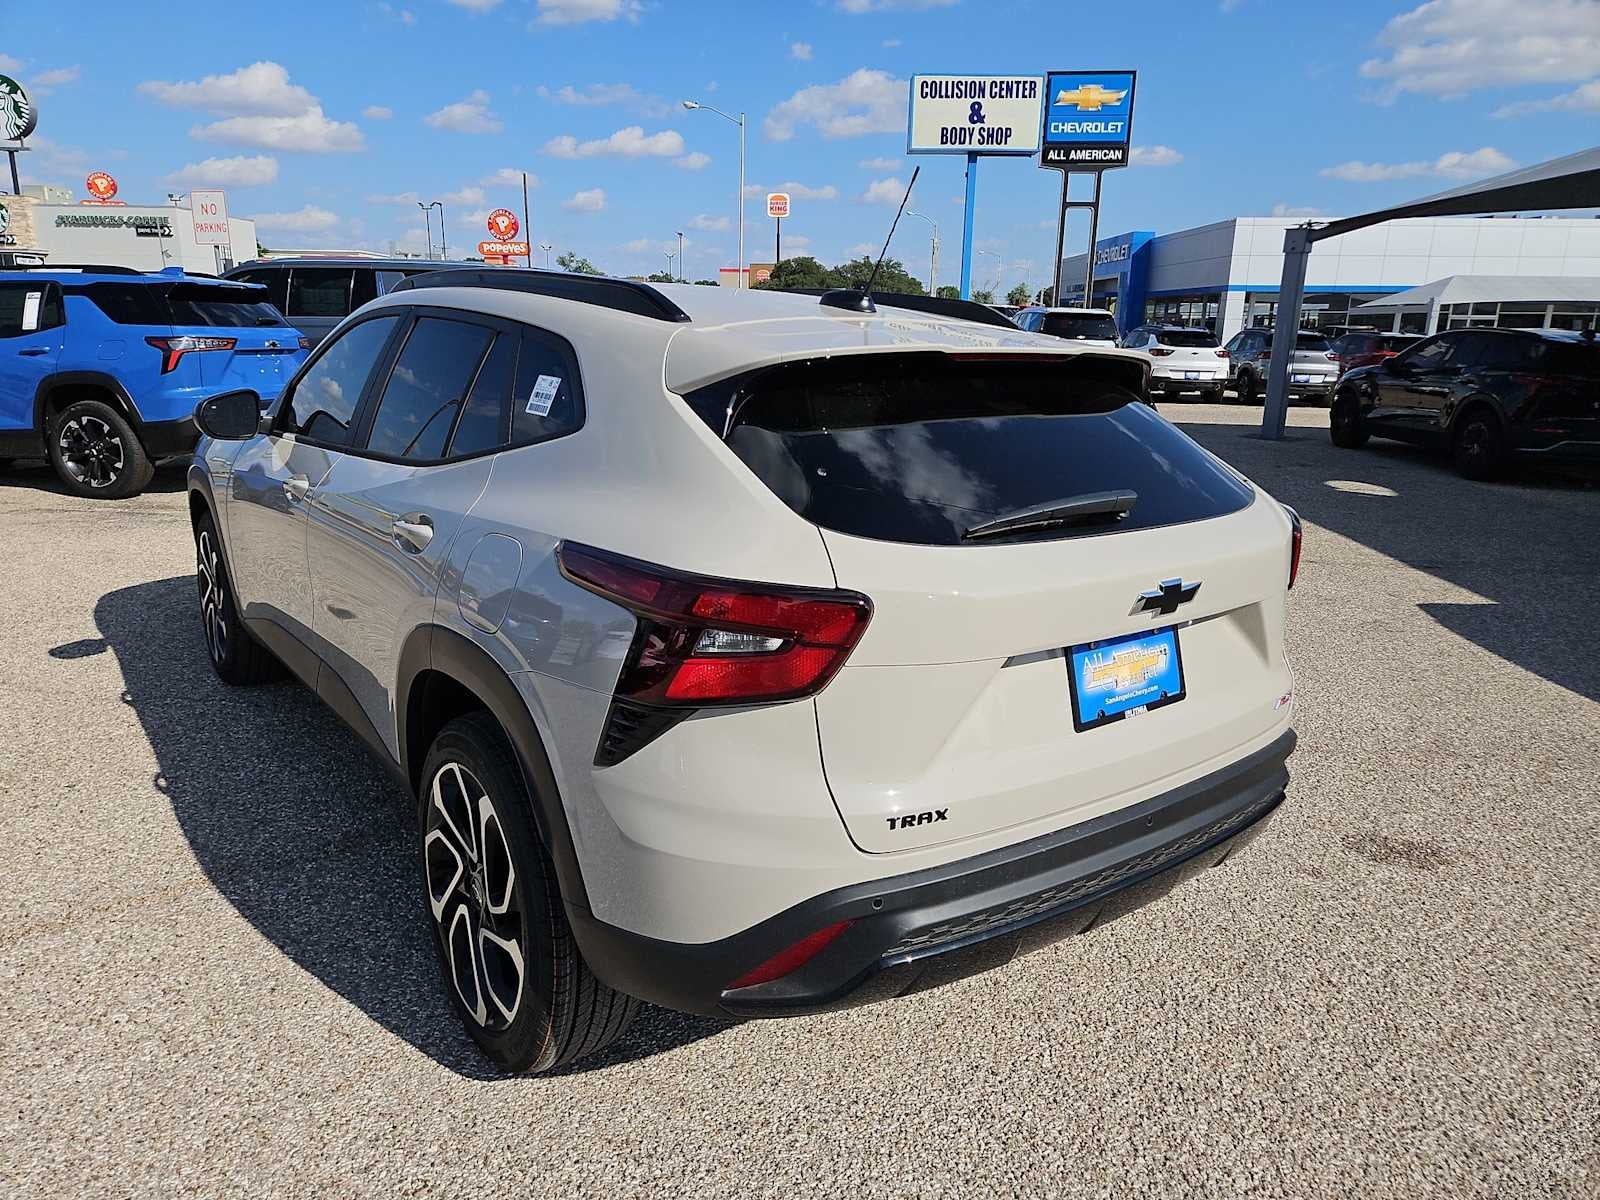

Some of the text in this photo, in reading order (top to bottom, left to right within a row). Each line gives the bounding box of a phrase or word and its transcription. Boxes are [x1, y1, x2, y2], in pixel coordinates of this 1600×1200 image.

[920, 80, 1037, 99] COLLISION CENTER
[968, 101, 985, 124] &
[1050, 121, 1124, 134] CHEVROLET
[940, 127, 1012, 146] BODY SHOP
[1047, 150, 1123, 160] ALL AMERICAN
[200, 203, 217, 216] NO
[55, 214, 125, 228] STARBUCKS
[195, 222, 227, 234] PARKING
[1097, 243, 1129, 265] CHEVROLET
[886, 808, 949, 830] TRAX
